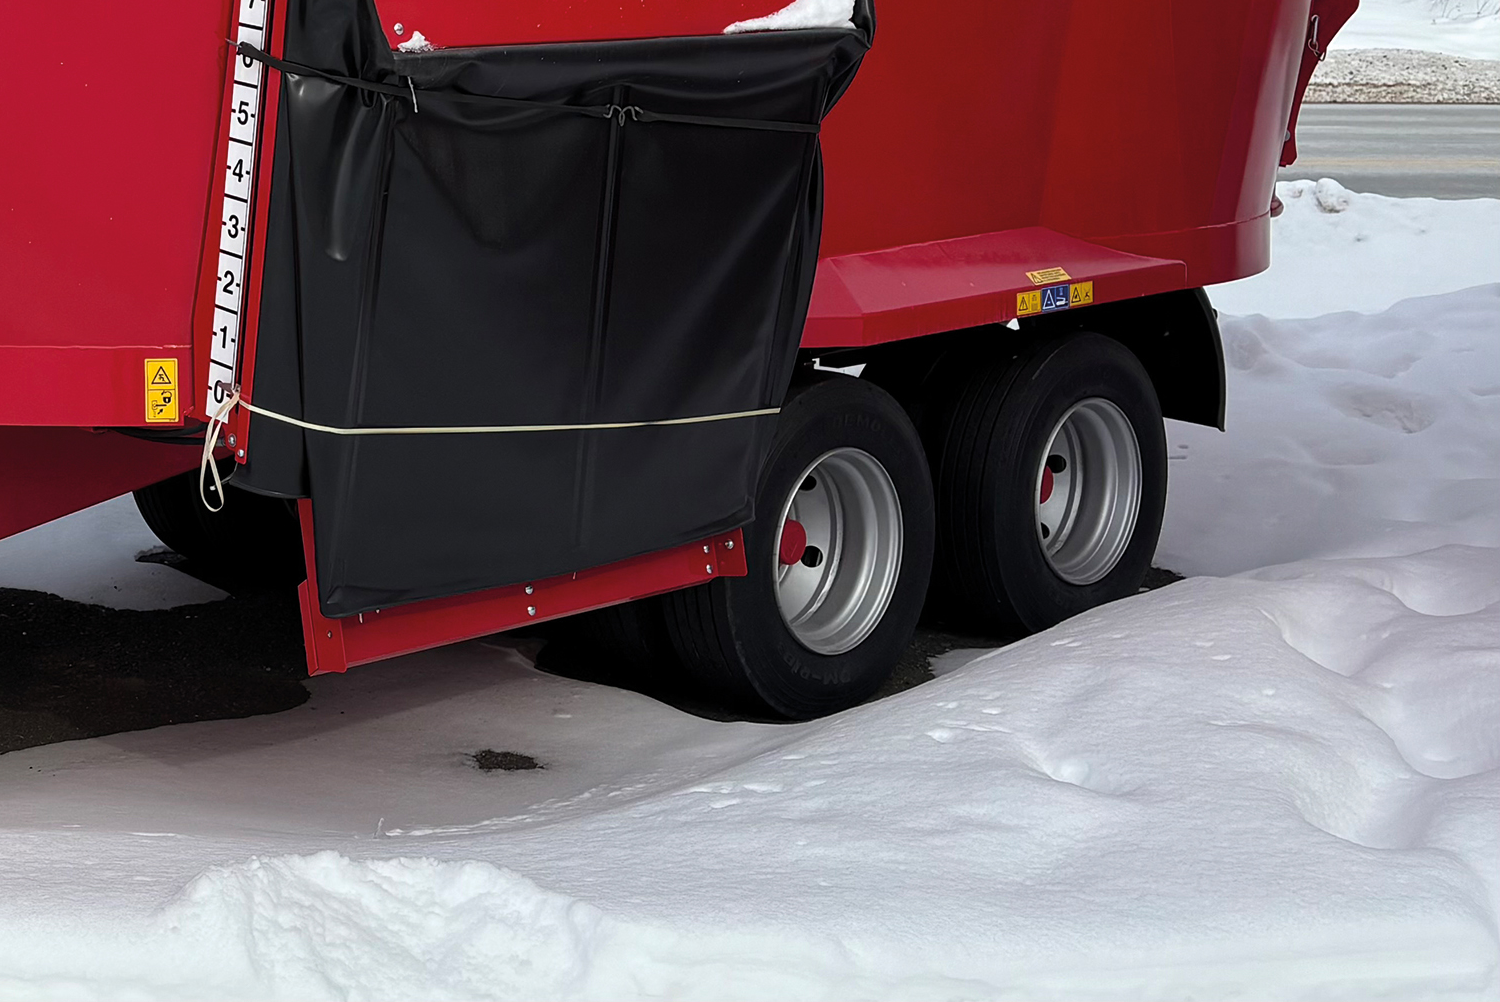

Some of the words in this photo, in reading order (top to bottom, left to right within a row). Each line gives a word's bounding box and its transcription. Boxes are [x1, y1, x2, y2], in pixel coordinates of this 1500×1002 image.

[237, 103, 249, 126] 5
[232, 159, 244, 182] 4
[227, 215, 239, 239] 3
[223, 270, 234, 294] 2
[219, 325, 228, 349] 1
[213, 379, 225, 403] 0
